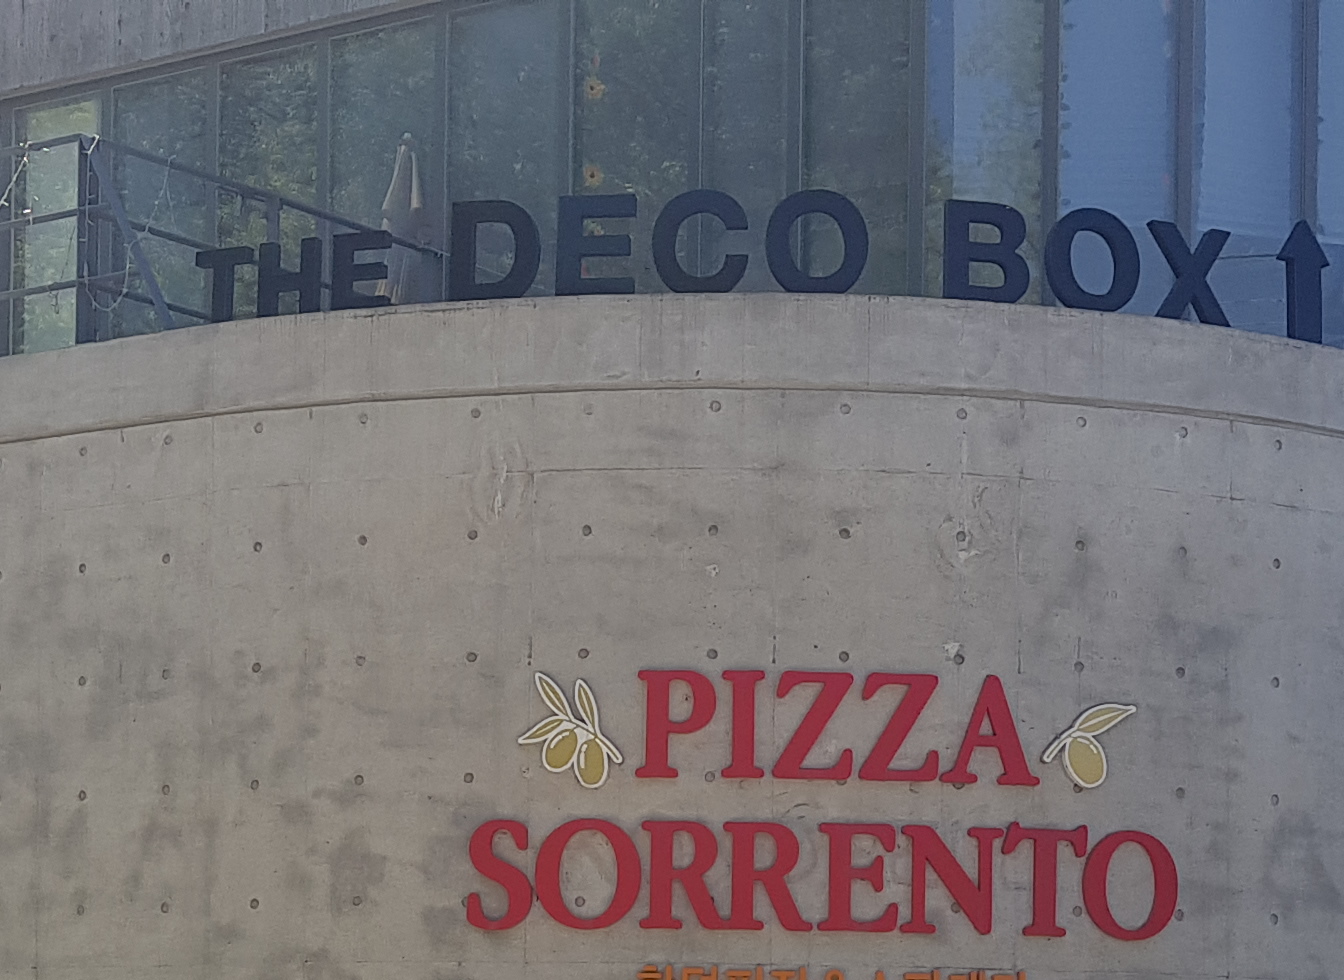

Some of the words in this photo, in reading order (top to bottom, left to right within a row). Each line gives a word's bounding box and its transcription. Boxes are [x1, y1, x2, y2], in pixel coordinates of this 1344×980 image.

[196, 230, 393, 323] THE
[451, 189, 869, 299] DECO
[943, 198, 1231, 328] BOX
[635, 670, 1040, 786] PIZZA
[465, 818, 1179, 942] SORRENTO
